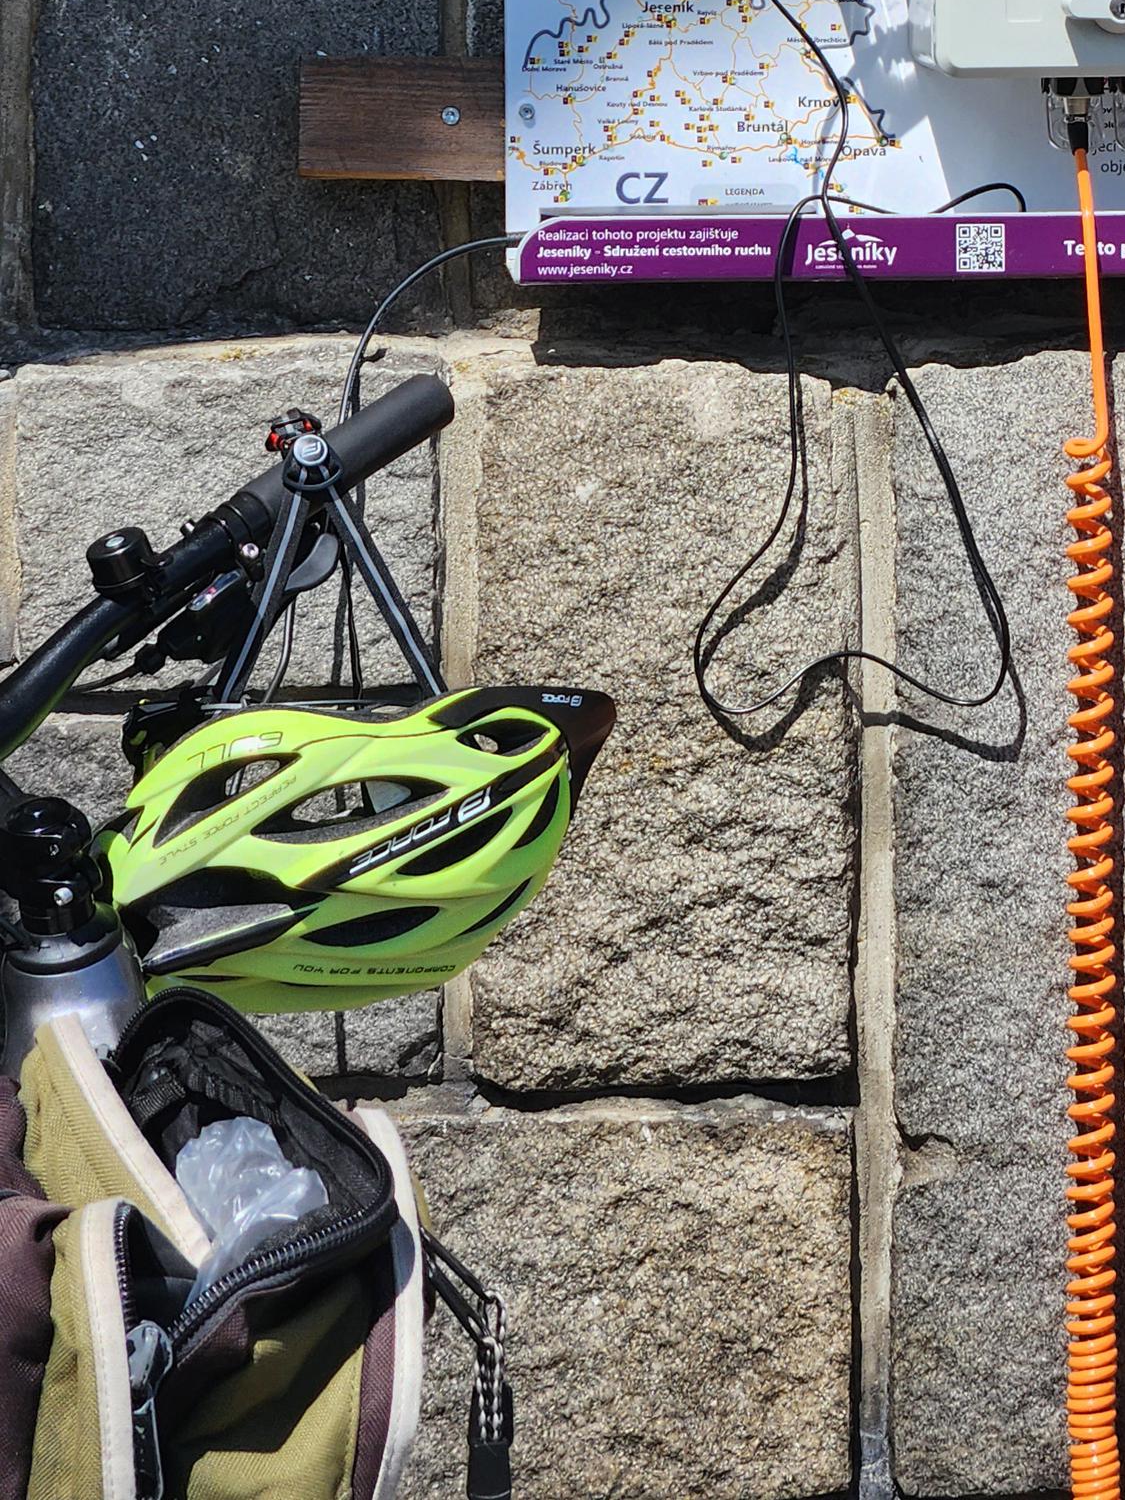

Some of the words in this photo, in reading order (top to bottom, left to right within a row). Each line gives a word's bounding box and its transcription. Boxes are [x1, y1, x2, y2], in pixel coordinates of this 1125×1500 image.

[641, 0, 694, 14] Jeseník
[736, 120, 789, 134] Bruntál
[532, 140, 597, 158] Šumperk
[842, 144, 887, 160] Opava
[532, 180, 573, 192] Zábřeh
[616, 172, 669, 205] CZ
[725, 188, 766, 197] LEGENDA
[537, 228, 590, 242] Realizaci
[591, 228, 634, 242] tohoto
[636, 227, 687, 244] projektu
[689, 226, 740, 244] zajišťuje
[536, 244, 592, 260] Jeseníky
[603, 244, 660, 258] Sdružení
[662, 242, 732, 257] cestovního
[734, 243, 772, 257] ruchu
[1063, 240, 1117, 256] Teto
[537, 262, 634, 278] www.jeseniky.cz
[542, 694, 570, 704] FORCE
[349, 806, 453, 875] FORCE
[292, 964, 324, 974] YOU
[329, 967, 362, 976] FOR
[367, 964, 457, 976] COMPONENTS
